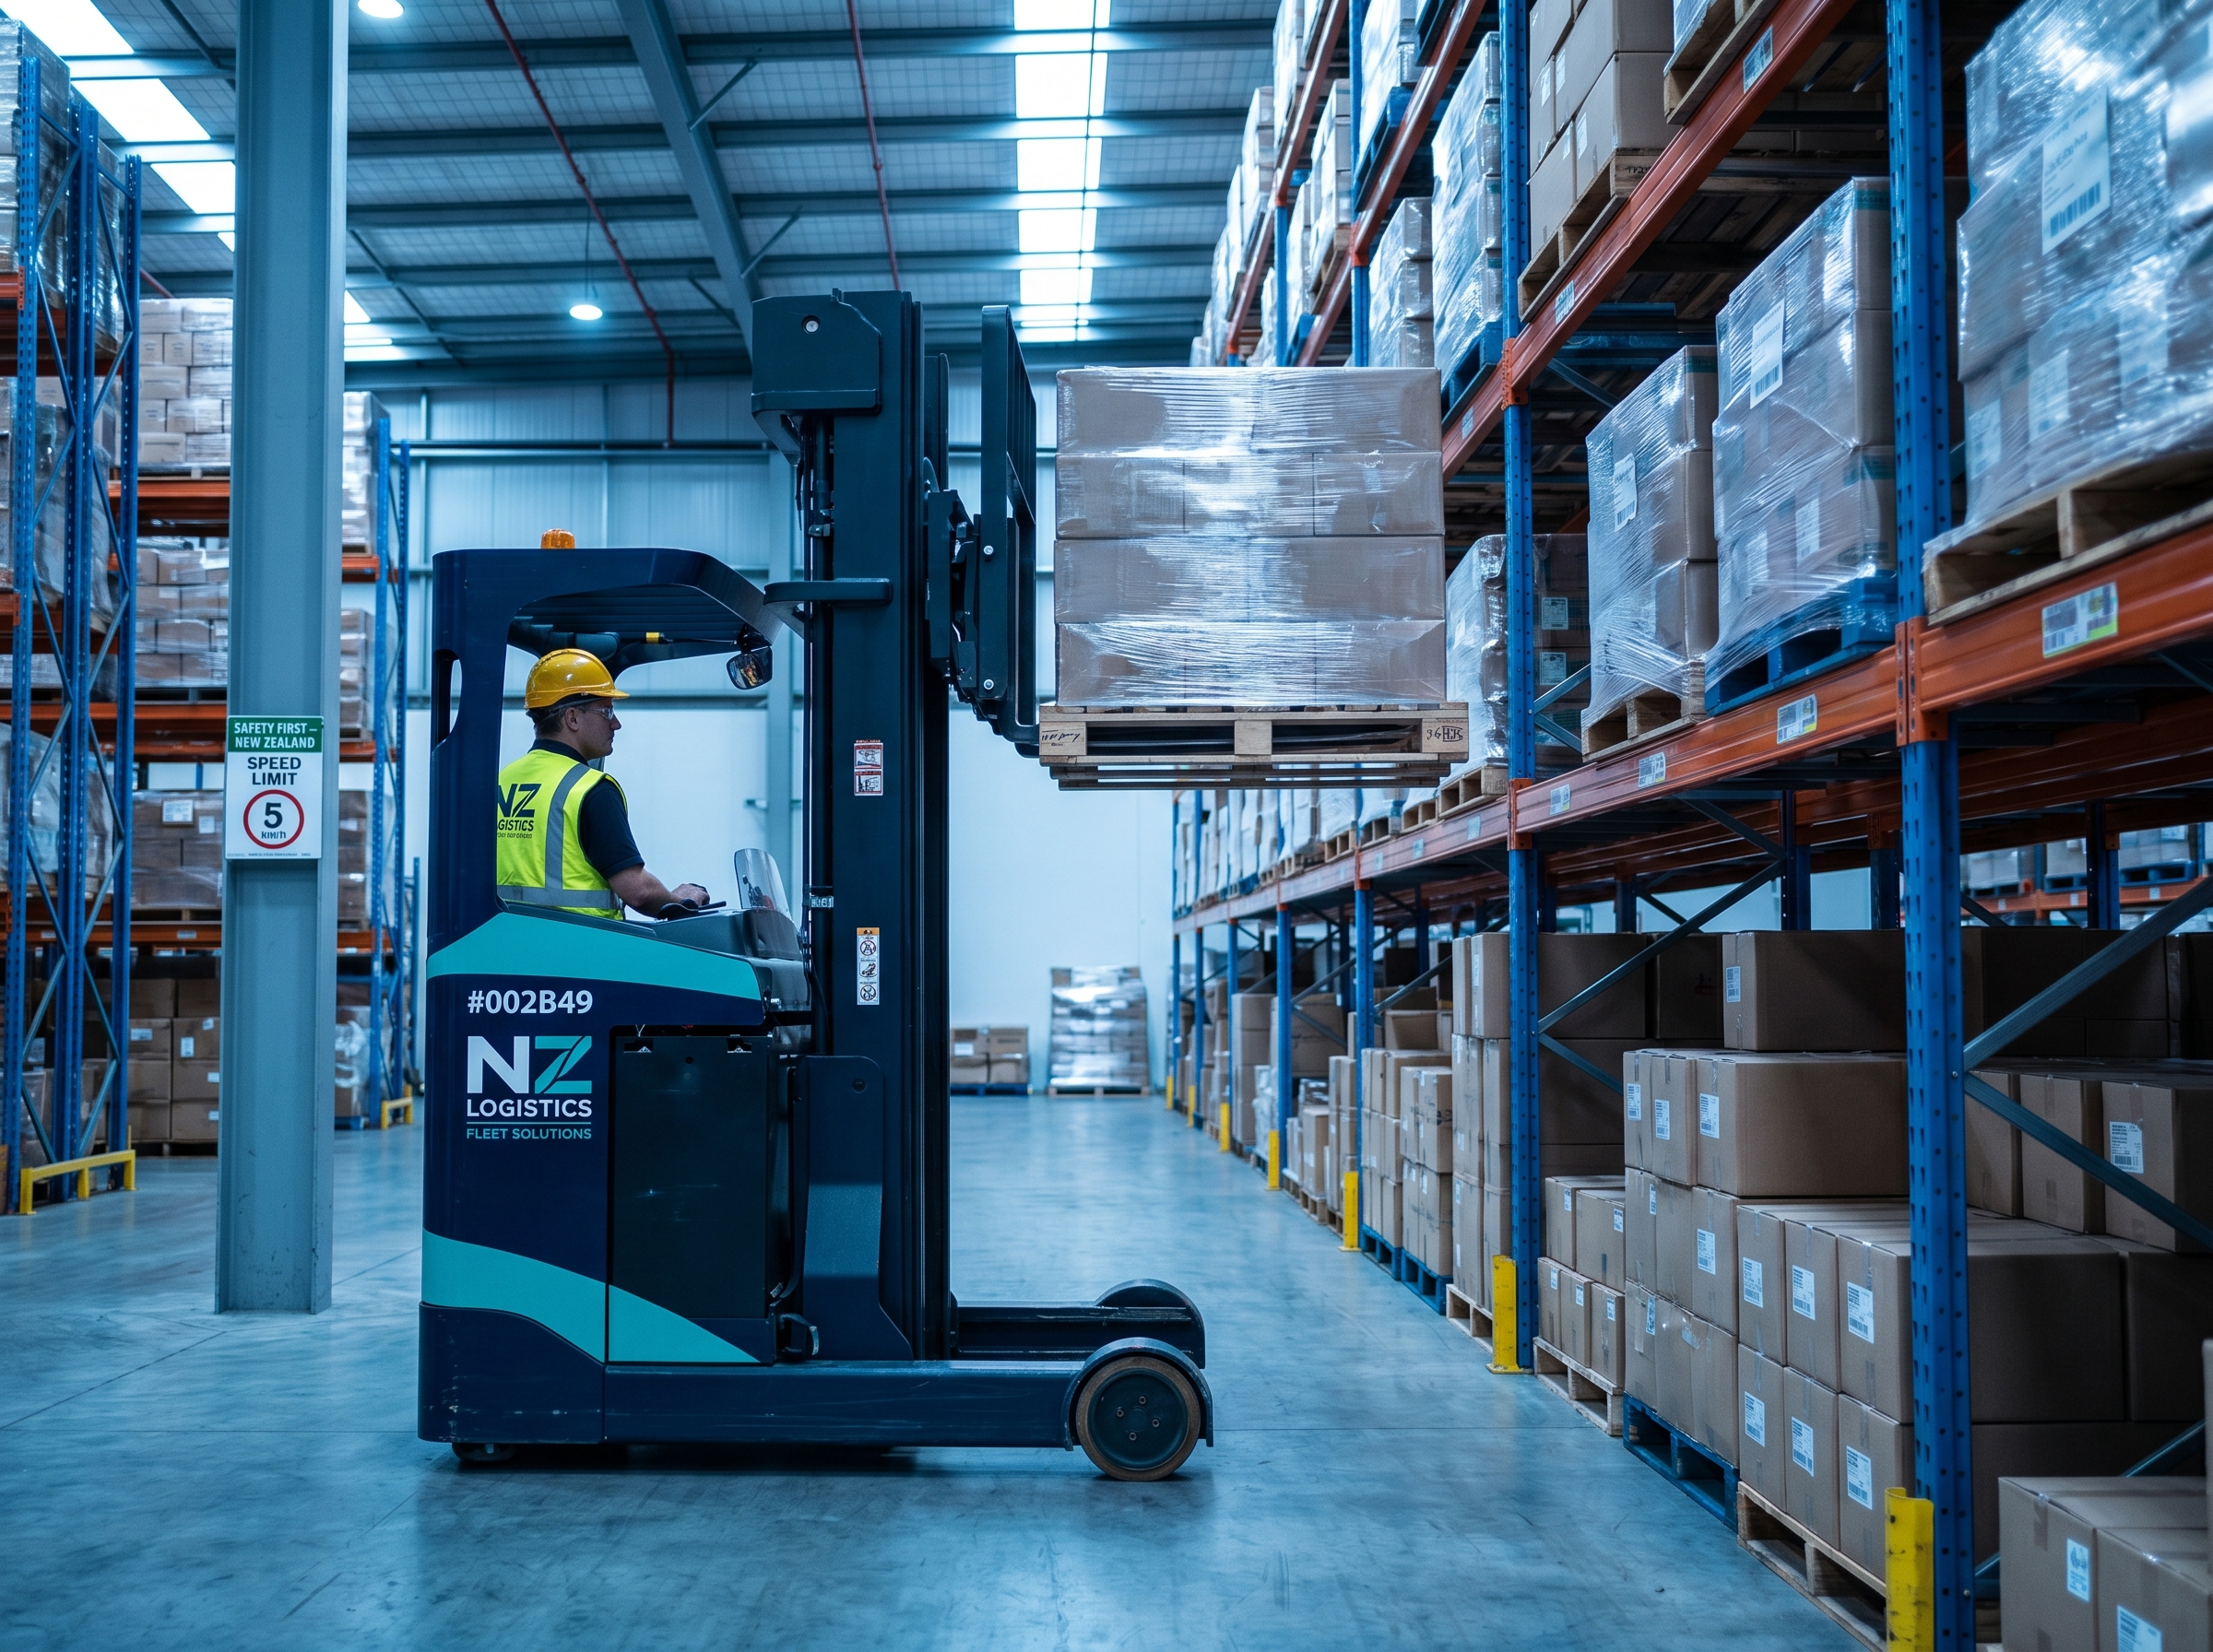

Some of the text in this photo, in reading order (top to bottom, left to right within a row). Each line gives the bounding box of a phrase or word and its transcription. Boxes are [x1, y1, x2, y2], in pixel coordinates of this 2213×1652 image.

[234, 723, 274, 734] SAFETY
[277, 723, 307, 734] FIRST
[235, 737, 315, 749] NEW ZEALAND
[247, 757, 302, 770] SPEED
[252, 773, 297, 785] LIMIT
[498, 784, 542, 818] NZ
[264, 802, 283, 829] 5
[499, 820, 534, 832] GISTICS
[467, 990, 593, 1014] #002B49
[467, 1035, 592, 1094] NZ
[467, 1099, 593, 1117] LOGISTICS
[467, 1128, 592, 1139] FLEET SOLUTIONS
